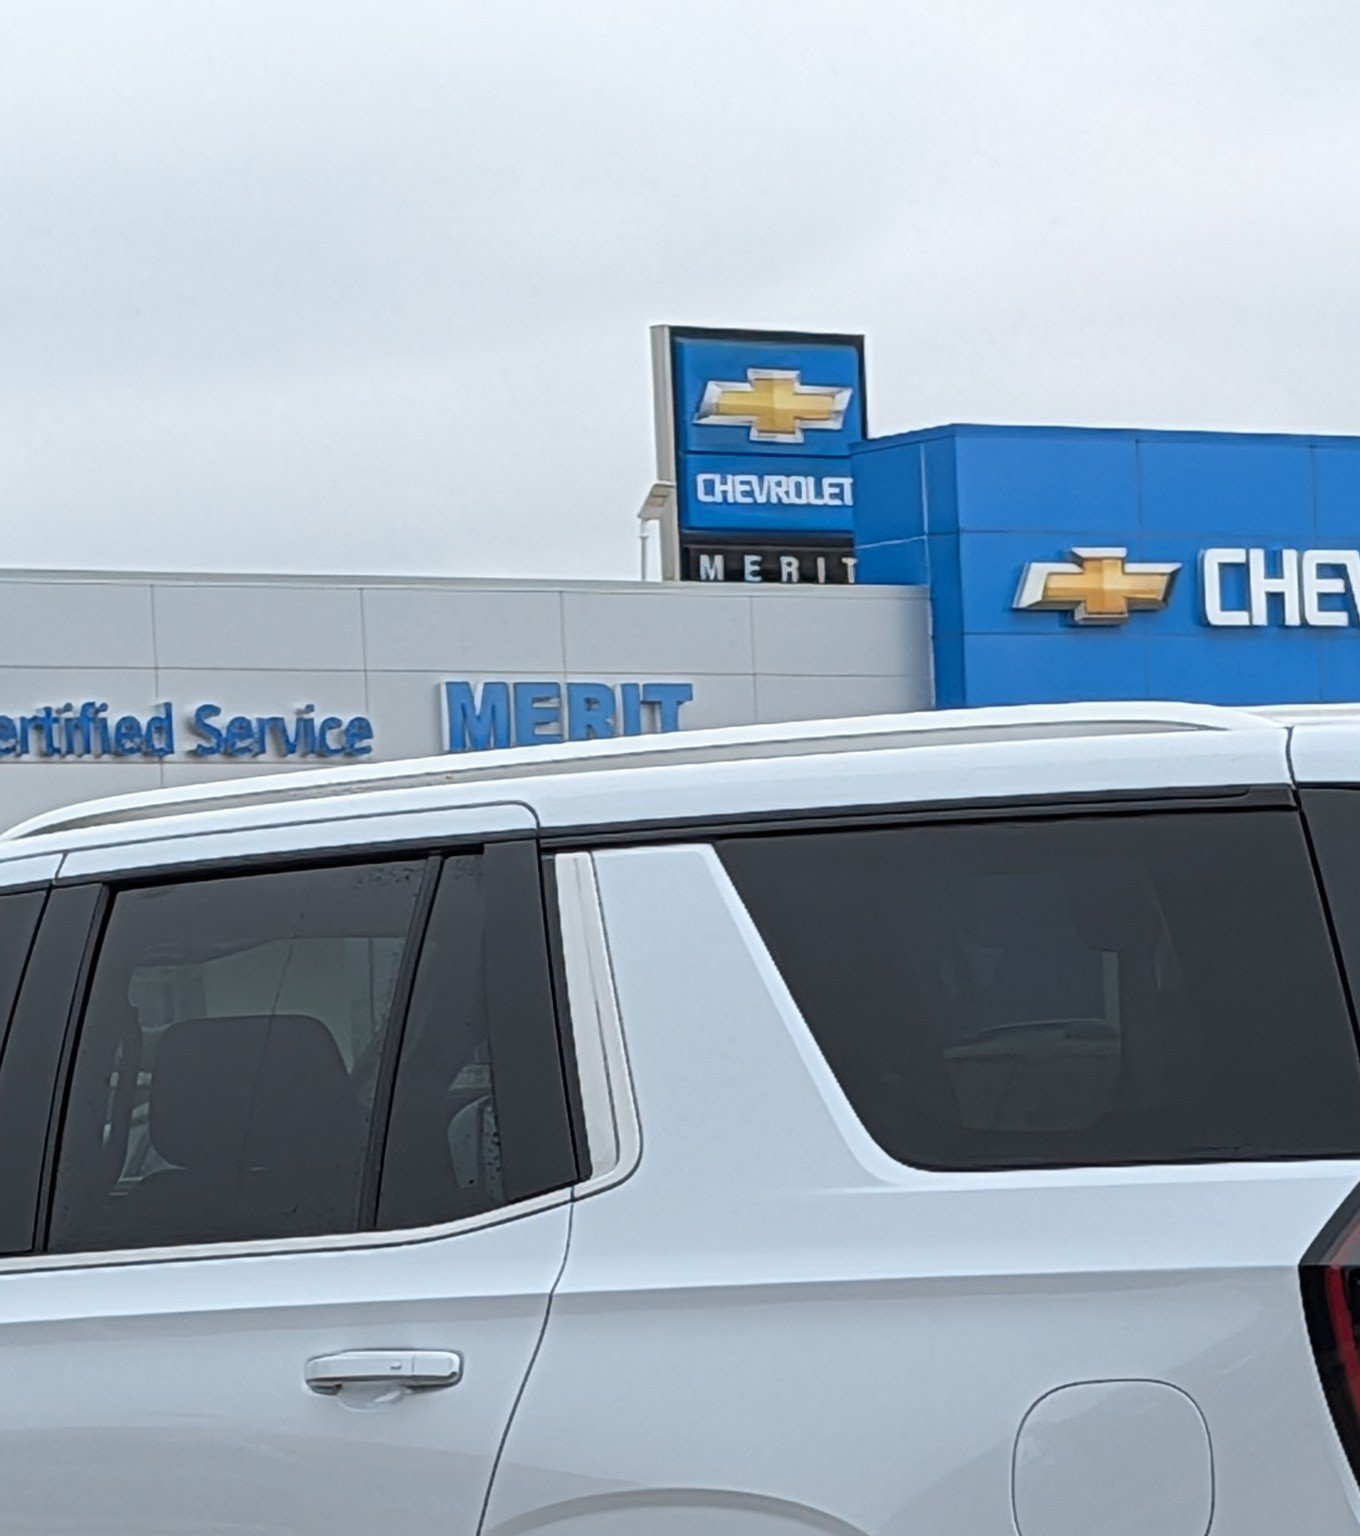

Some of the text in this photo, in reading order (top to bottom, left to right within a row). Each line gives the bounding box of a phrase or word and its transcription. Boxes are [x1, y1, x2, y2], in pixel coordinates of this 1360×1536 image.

[696, 473, 854, 506] CHEVROLET
[698, 554, 857, 584] MERIT
[189, 703, 374, 757] Service
[444, 681, 694, 754] MERIT
